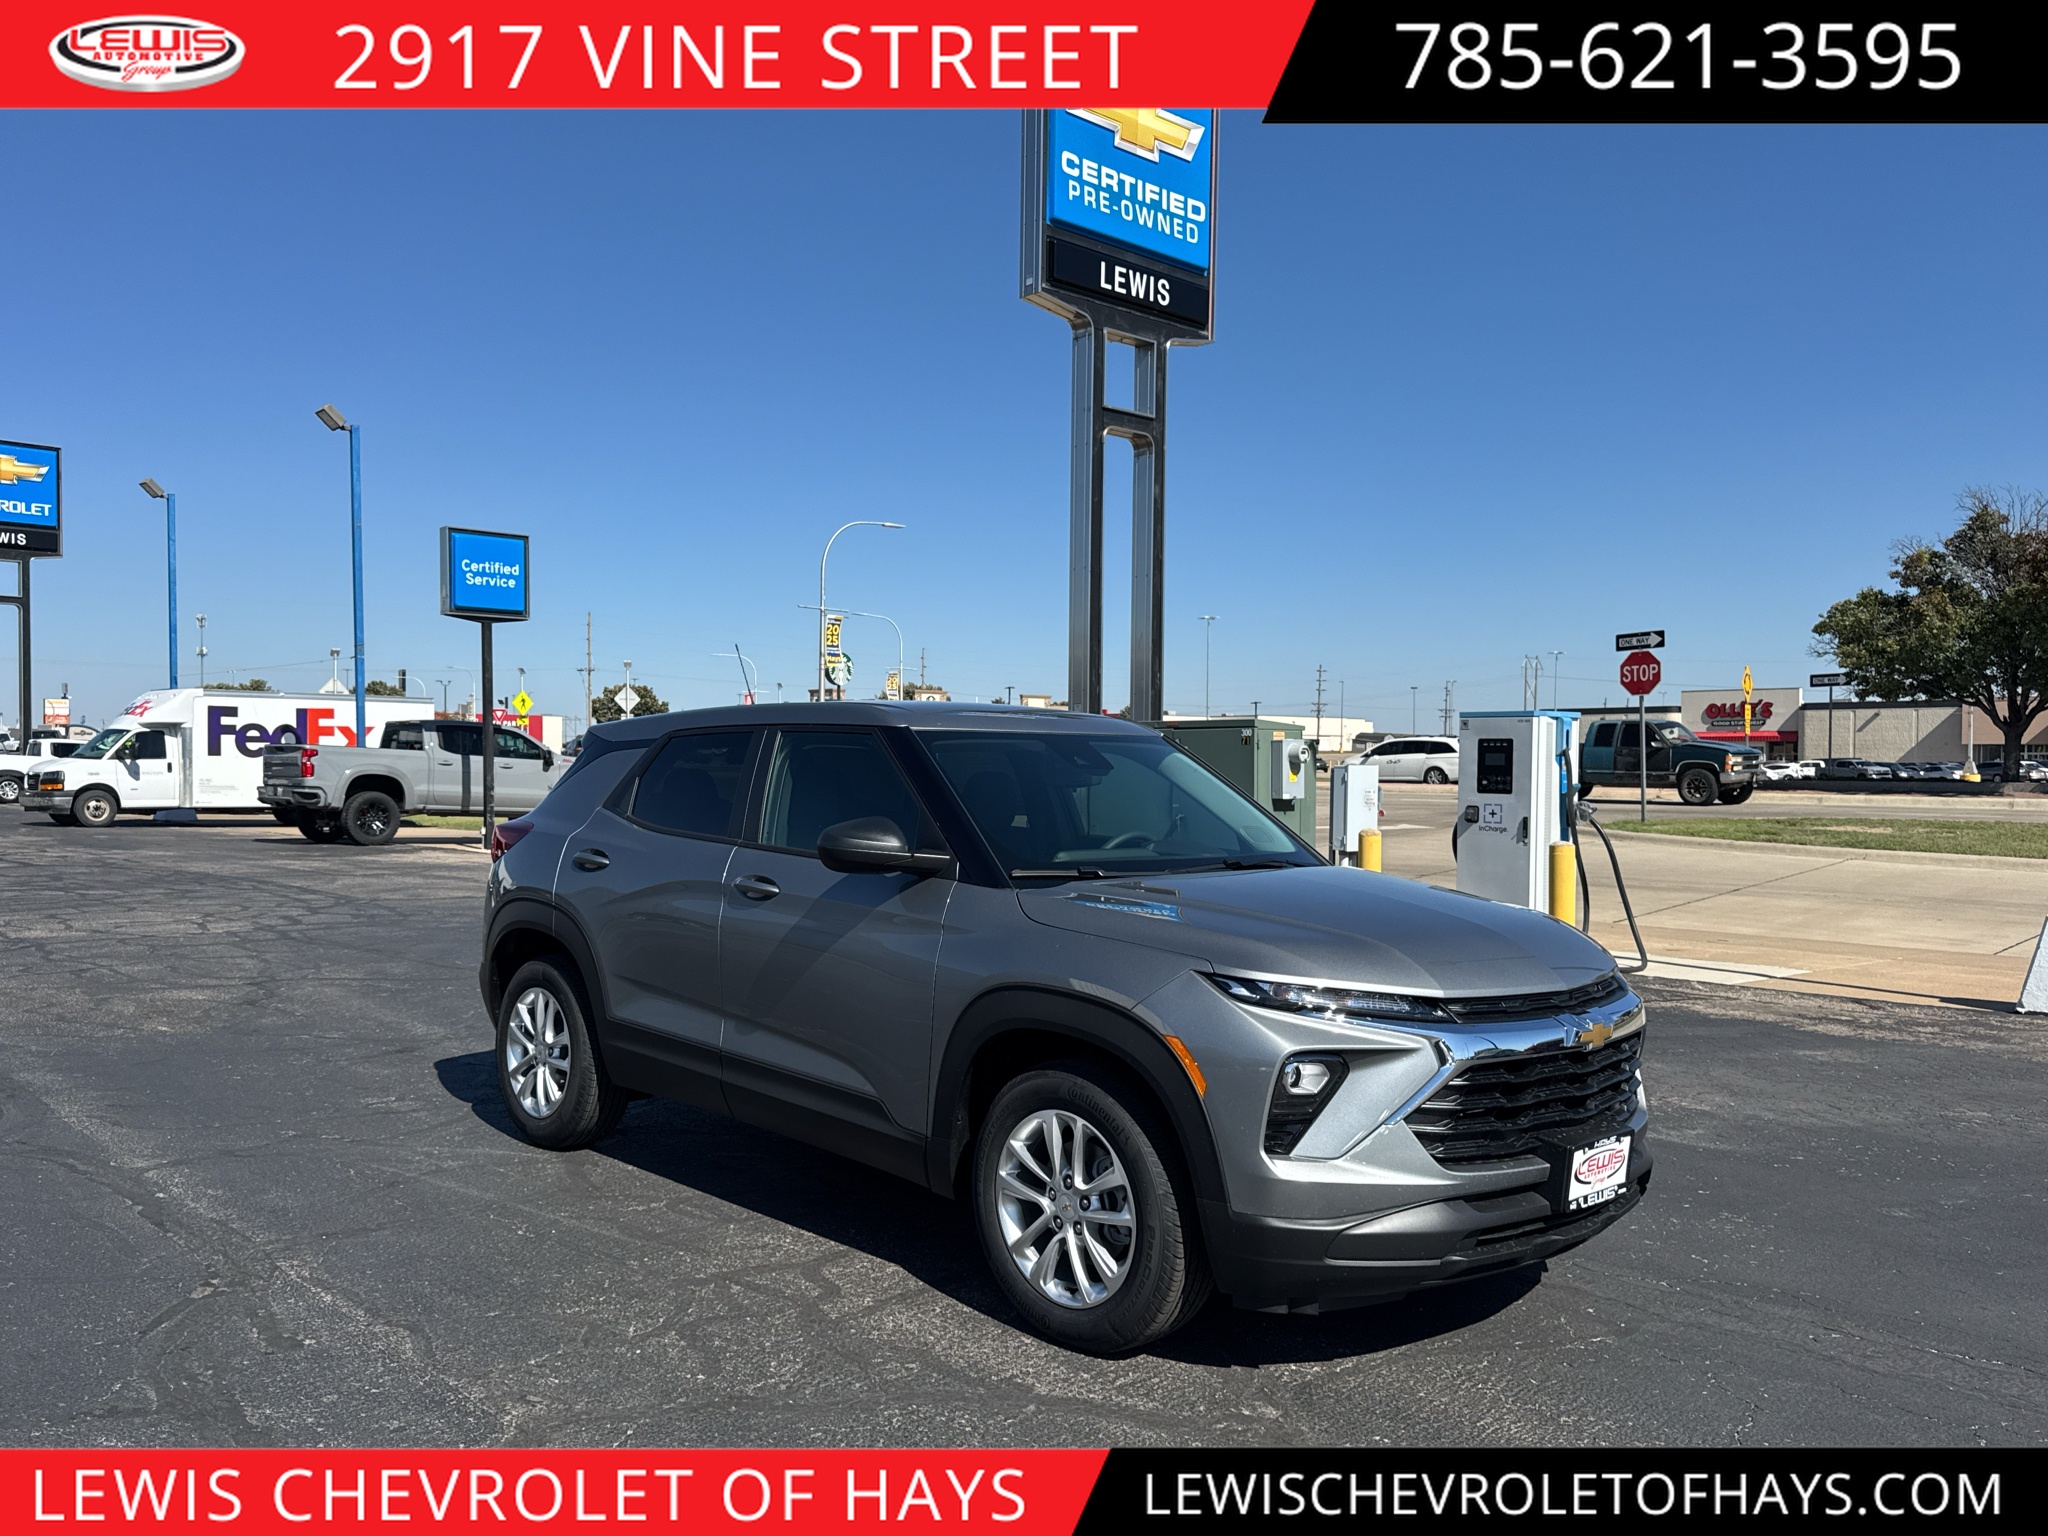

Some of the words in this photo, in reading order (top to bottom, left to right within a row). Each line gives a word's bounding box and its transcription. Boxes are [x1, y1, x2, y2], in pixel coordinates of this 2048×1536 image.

[1062, 150, 1205, 223] CERTIFIED
[1068, 180, 1199, 244] PRE-OWNED
[1100, 261, 1170, 306] LEWIS
[461, 559, 519, 576] Certified
[465, 573, 516, 588] Service
[1620, 639, 1633, 647] ONE
[1636, 637, 1650, 645] WAY
[1622, 663, 1659, 683] STOP
[1241, 728, 1252, 736] 300
[1067, 1084, 1126, 1137] Continental
[1577, 1148, 1624, 1176] LEWIS
